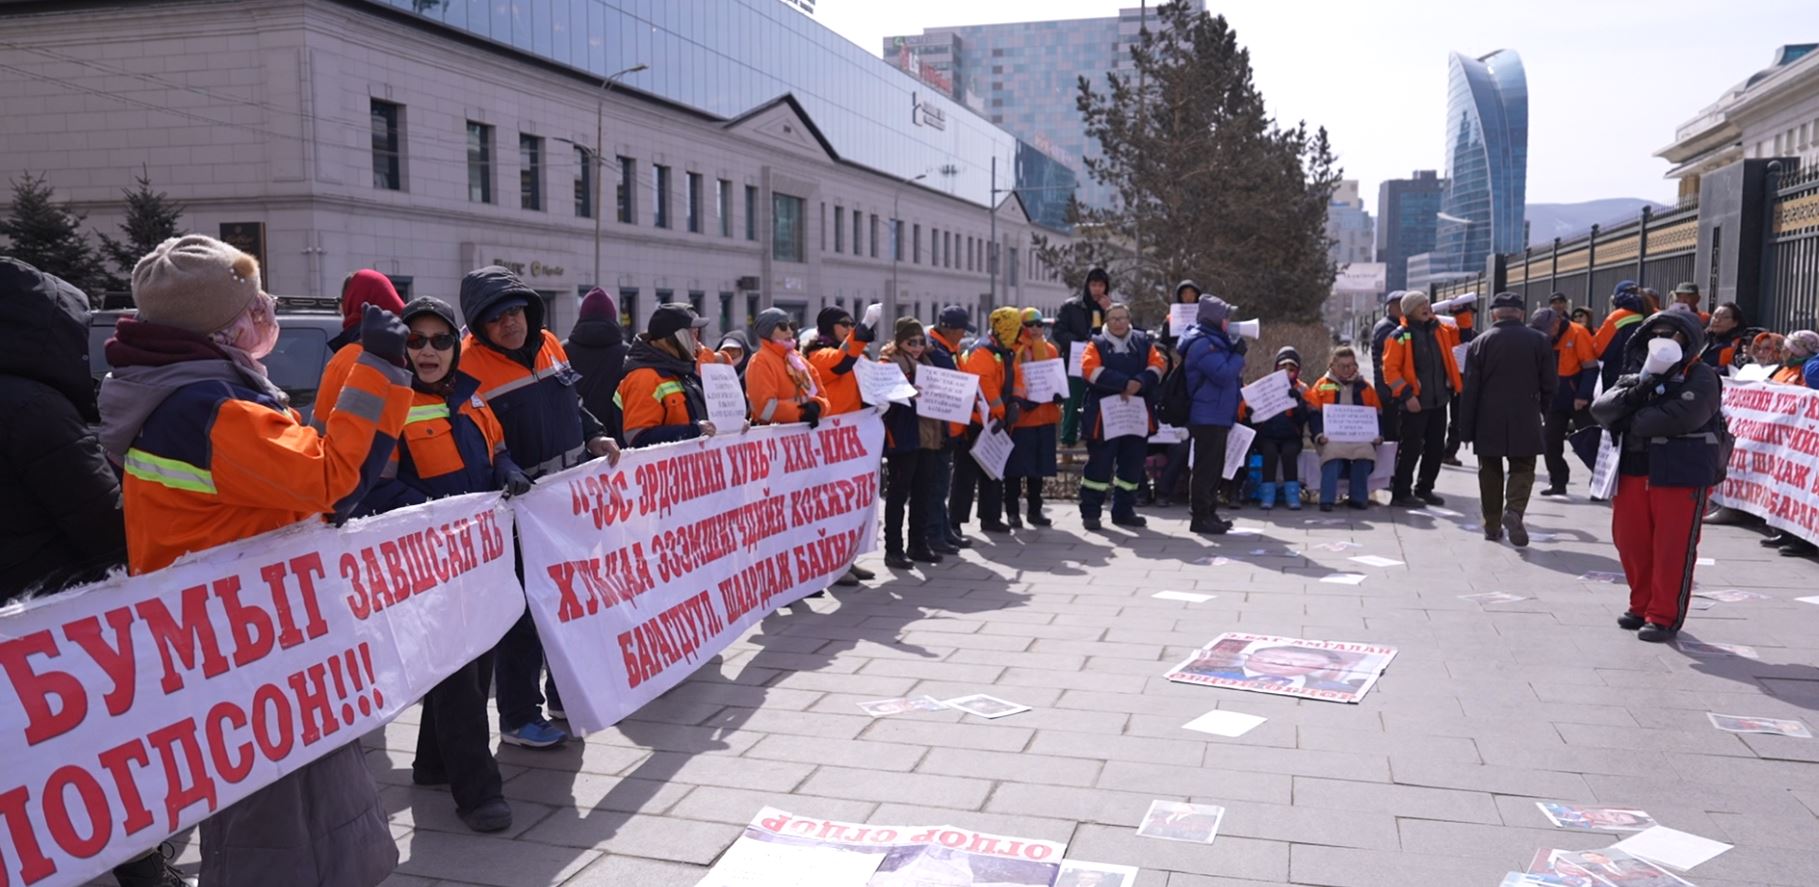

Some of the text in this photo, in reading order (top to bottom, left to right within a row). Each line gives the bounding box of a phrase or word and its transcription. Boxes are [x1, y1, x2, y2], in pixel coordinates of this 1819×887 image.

[636, 441, 726, 519] ЭРДЭНИЙН
[780, 419, 868, 478] ХХК-ИЙН
[340, 518, 478, 620] ЗАВШСАН
[475, 508, 504, 563] НЬ
[718, 551, 793, 626] ШААРДАЖ
[912, 827, 1054, 861] ОГЦОР
